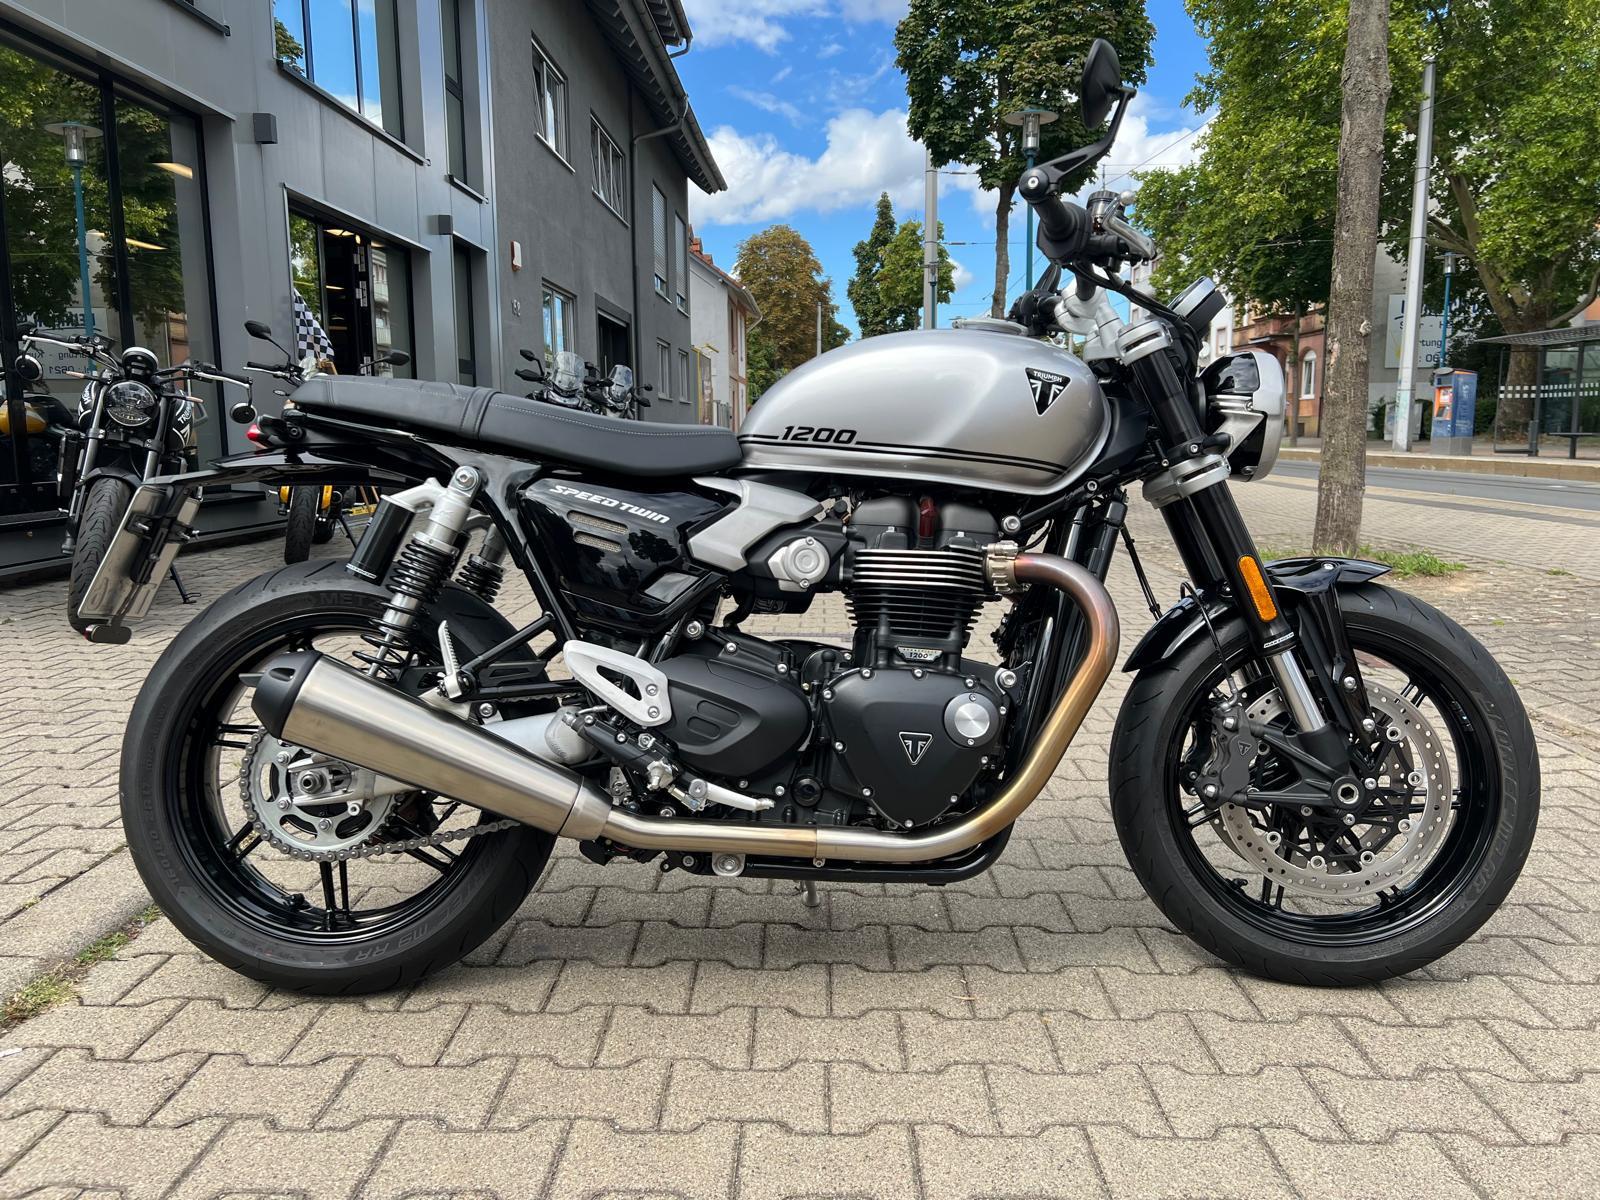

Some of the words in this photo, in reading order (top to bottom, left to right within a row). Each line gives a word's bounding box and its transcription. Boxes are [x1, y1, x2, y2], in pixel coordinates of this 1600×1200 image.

[1033, 370, 1063, 383] TRIUMPH
[780, 425, 857, 445] 1200
[549, 484, 620, 508] SPEED
[619, 502, 671, 524] TWIN
